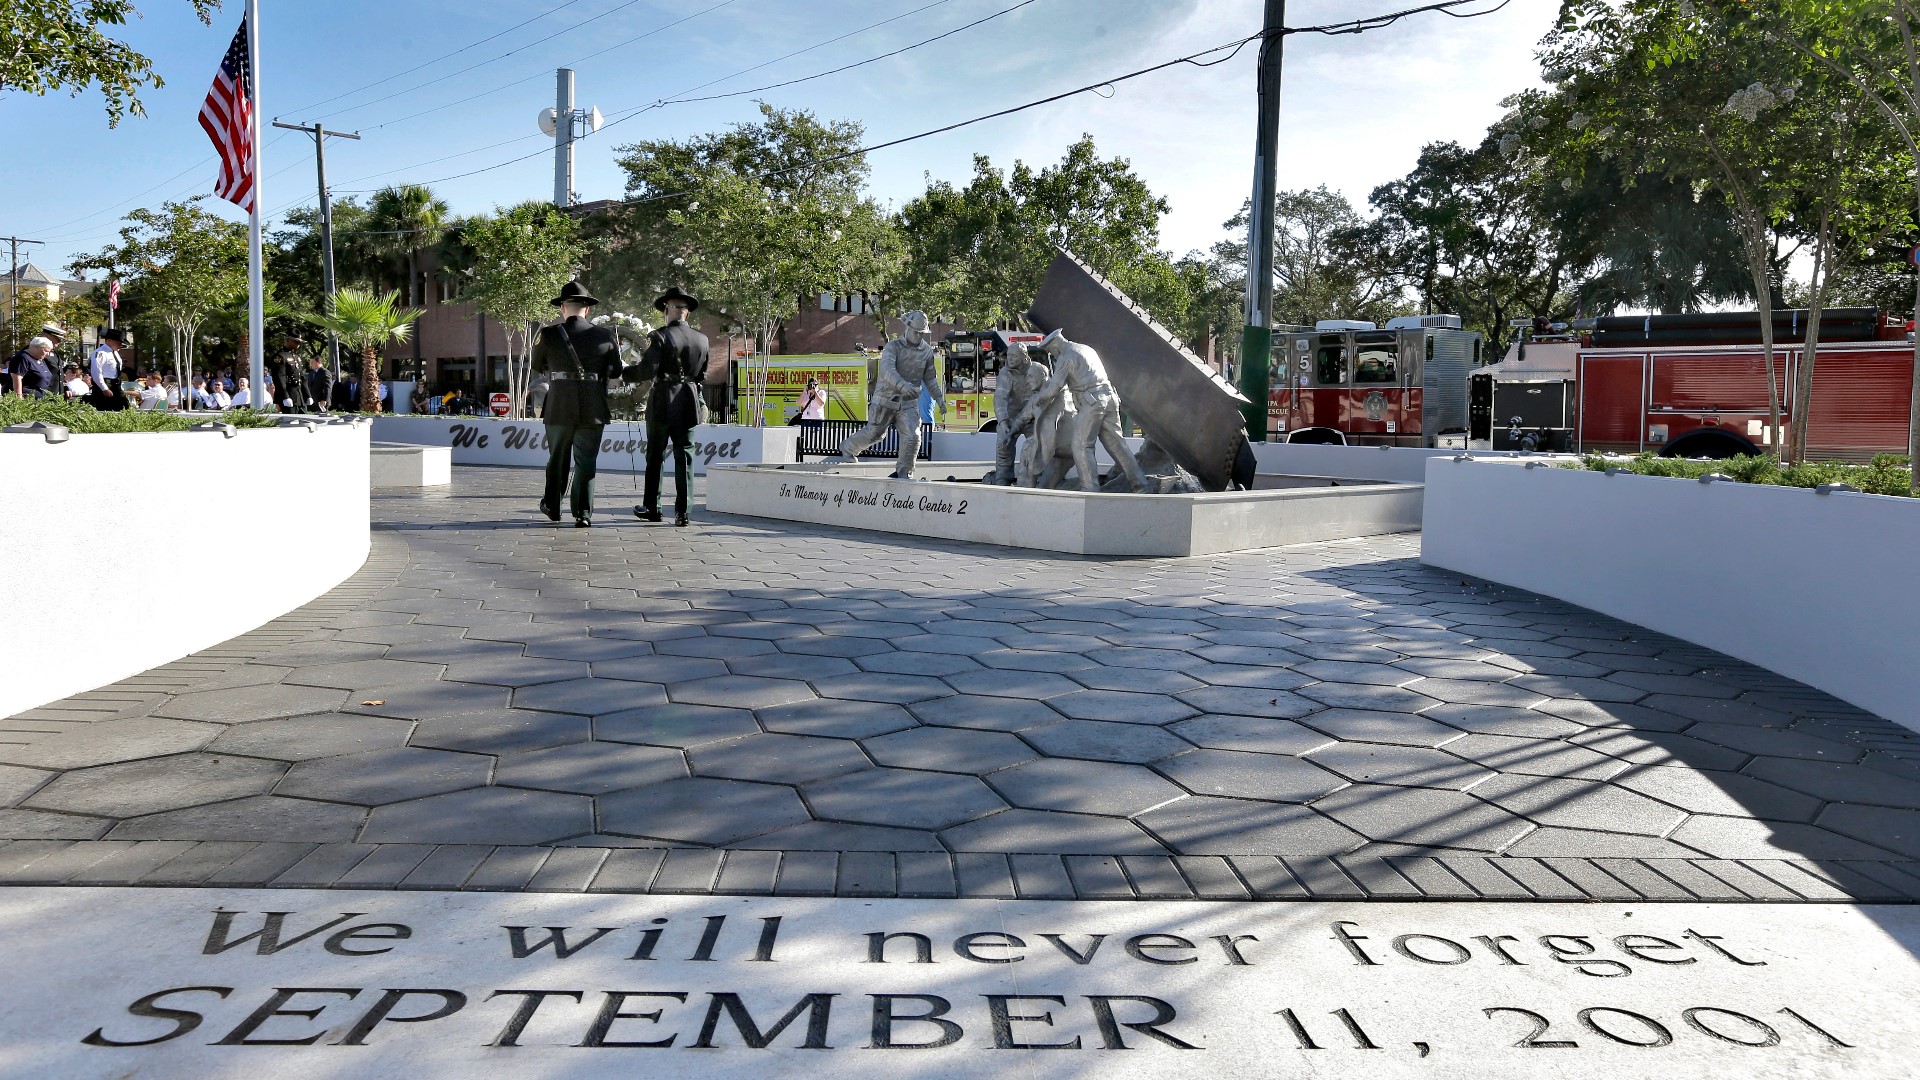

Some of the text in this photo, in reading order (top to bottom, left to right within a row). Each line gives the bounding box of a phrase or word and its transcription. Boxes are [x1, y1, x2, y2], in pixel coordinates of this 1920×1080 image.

[790, 371, 815, 384] COUNTY
[832, 371, 859, 384] RESCUE
[1299, 355, 1310, 370] 5
[956, 400, 975, 419] E1
[449, 424, 489, 449] We
[501, 426, 549, 450] Wil
[601, 438, 647, 454] ever
[779, 483, 968, 515] In Memory of World Trade Center 2
[202, 910, 1768, 978] We will never forget
[81, 985, 1857, 1058] SEPTEMBER 11, 2001
